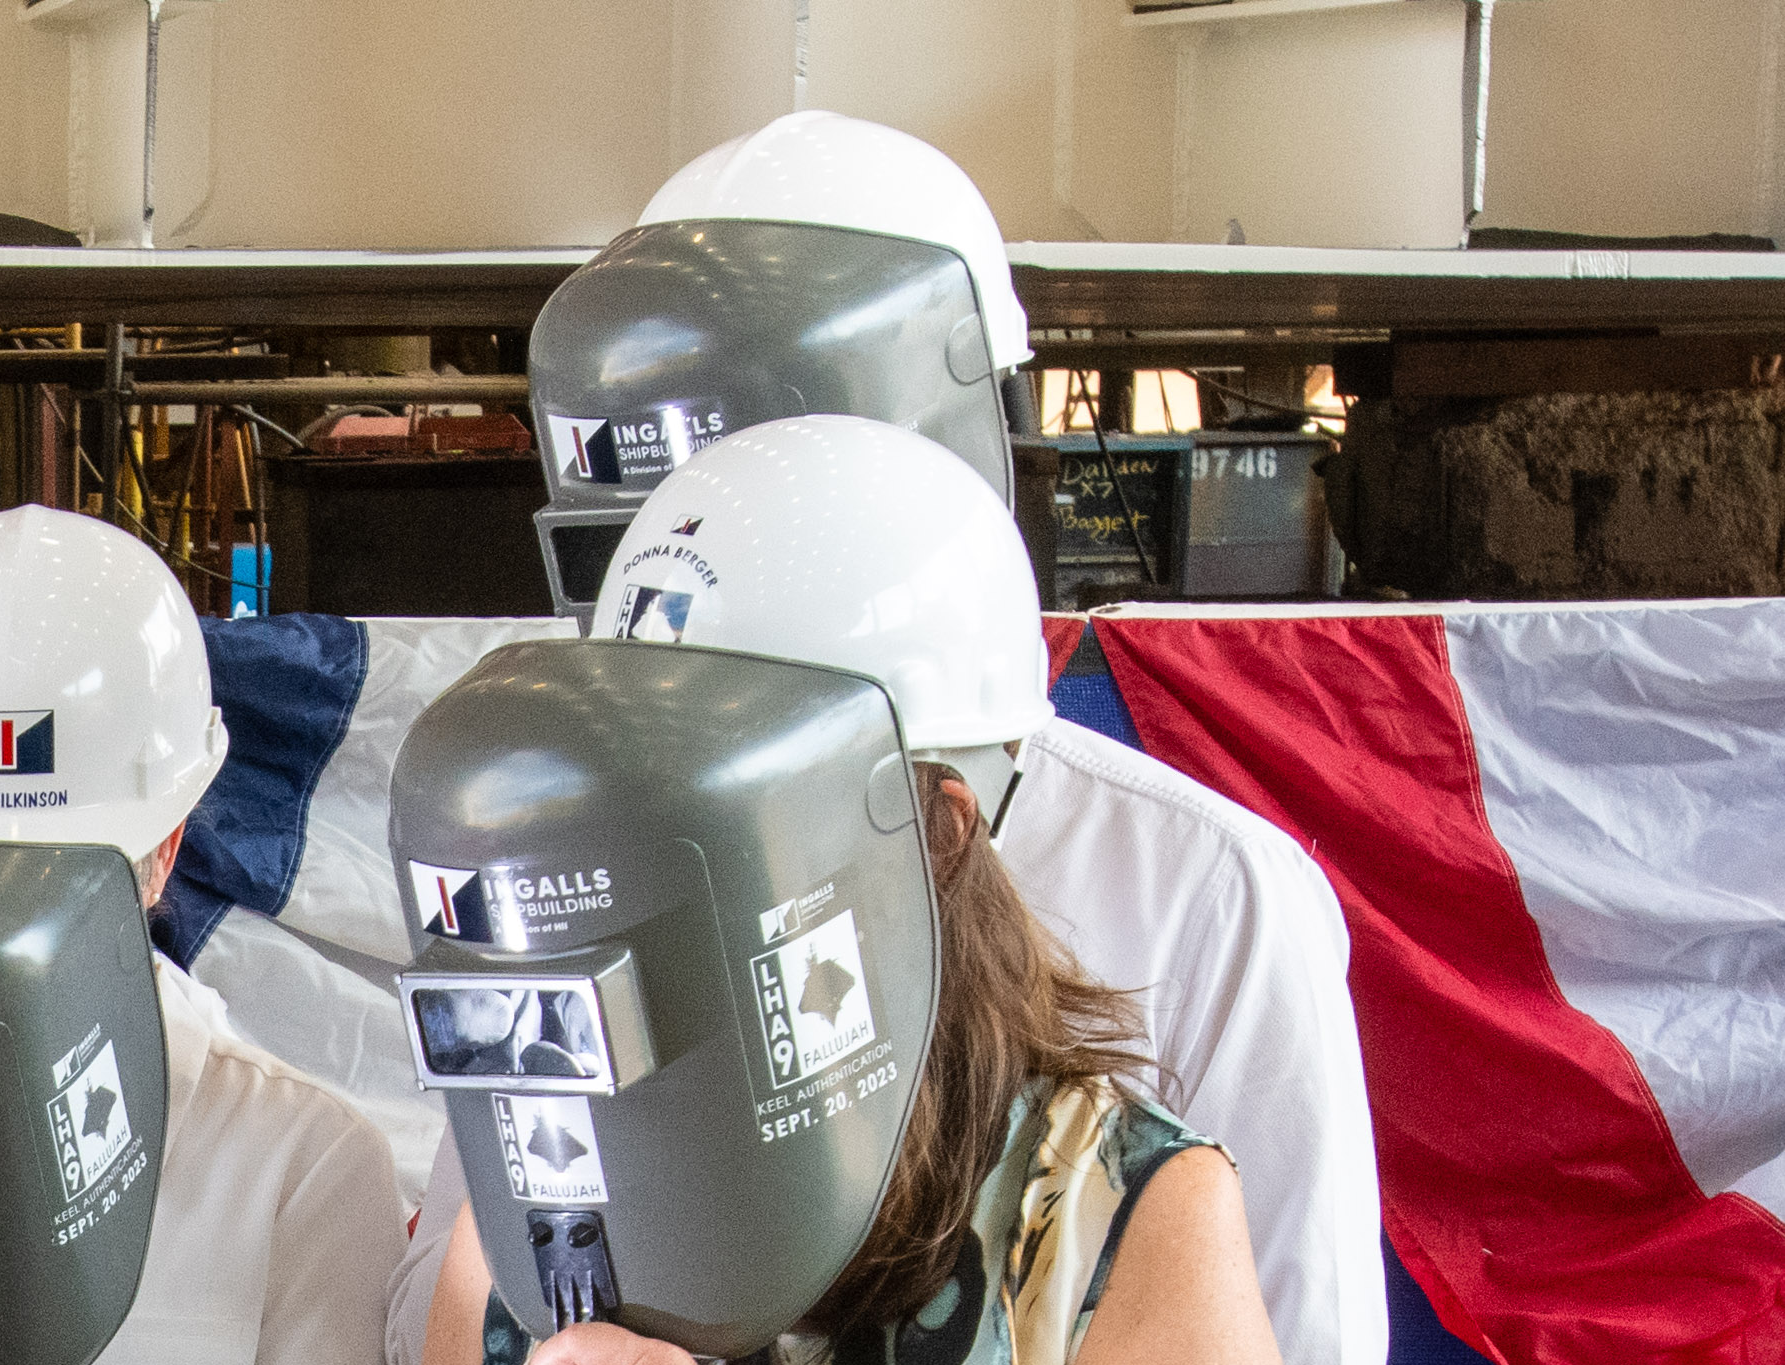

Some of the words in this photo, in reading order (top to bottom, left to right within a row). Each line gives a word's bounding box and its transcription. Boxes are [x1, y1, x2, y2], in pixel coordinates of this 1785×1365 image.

[613, 412, 724, 444] INGALS
[623, 544, 670, 575] DONNA
[674, 546, 718, 588] BERGER
[490, 893, 613, 919] SPBUILDING
[798, 881, 834, 909] INGALLS
[760, 962, 794, 1076] LHA9
[804, 1020, 869, 1069] FALLUJAH
[757, 1096, 791, 1117] KEEL
[796, 1039, 893, 1102] AUTHENTICATION
[760, 1107, 819, 1143] SEPT.
[825, 1090, 853, 1118] 20,
[857, 1061, 898, 1099] 2023
[54, 1104, 80, 1190] LHA9
[54, 1204, 80, 1225] KEEL
[83, 1134, 143, 1208] AUTHENTICATION
[86, 1124, 128, 1179] FALLUJAH
[498, 1100, 525, 1193] LHA9
[58, 1211, 99, 1246] SEPT.
[102, 1189, 121, 1214] 20,
[122, 1151, 148, 1191] 2023
[532, 1184, 601, 1197] FALLUJAH
